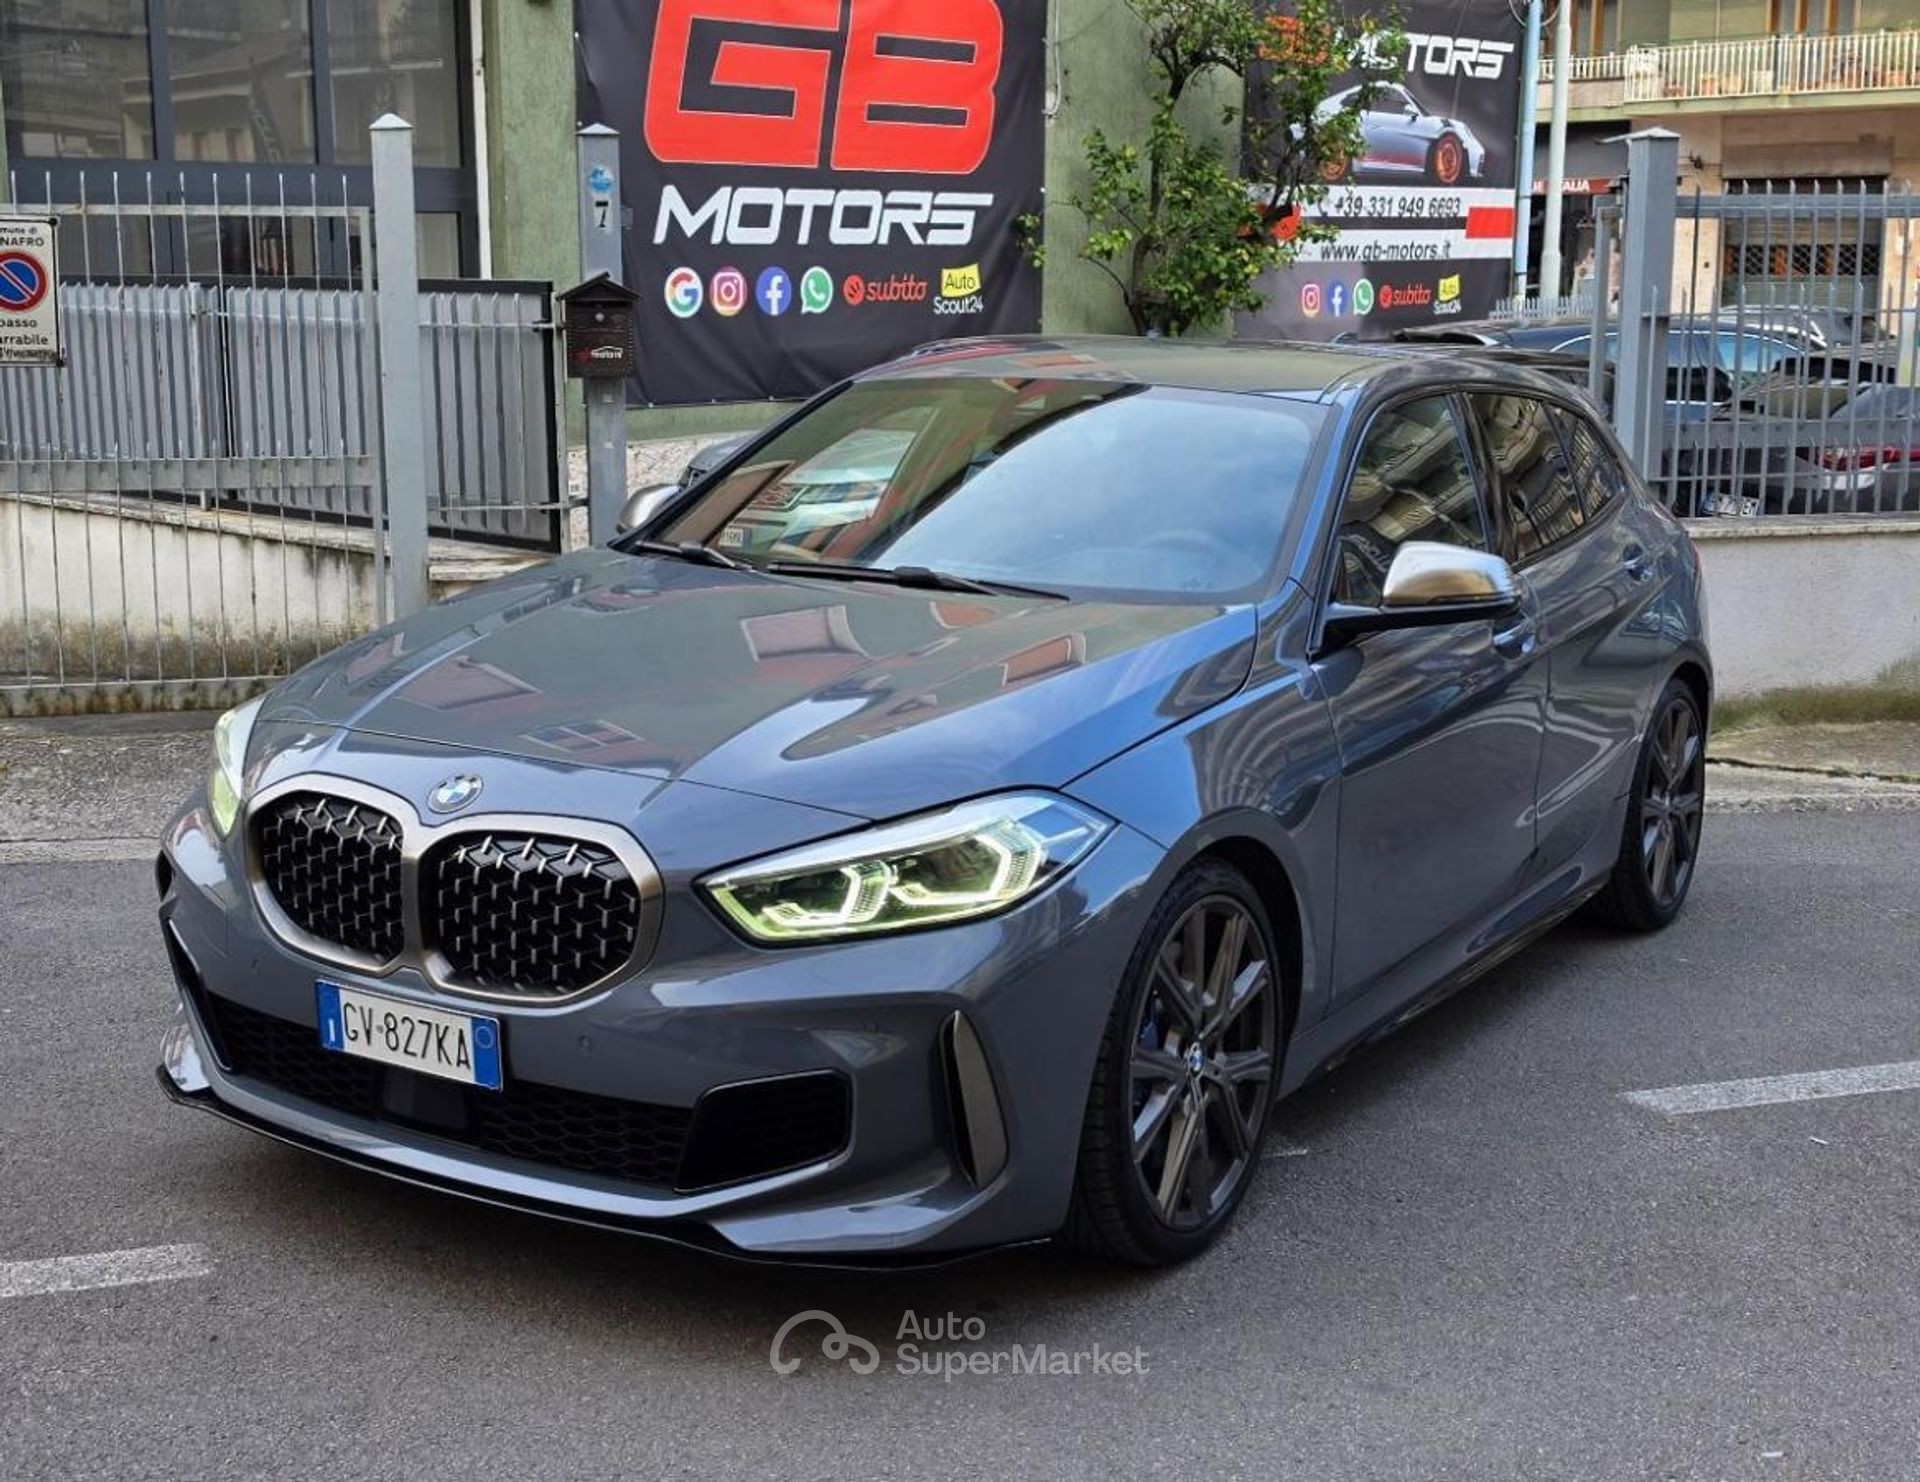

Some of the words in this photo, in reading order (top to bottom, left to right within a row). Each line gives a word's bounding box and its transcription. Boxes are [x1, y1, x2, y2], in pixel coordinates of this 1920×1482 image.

[644, 0, 1003, 174] GB
[595, 201, 608, 228] 7
[654, 184, 993, 245] MOTORS
[1335, 196, 1363, 217] +39
[1367, 196, 1393, 217] 331
[1398, 196, 1424, 217] 949
[1429, 196, 1460, 218] 6693
[1320, 239, 1451, 261] www.gb-motors.it
[866, 274, 928, 301] subito
[944, 272, 976, 290] Auto
[1393, 280, 1432, 306] subito
[933, 296, 985, 314] Scout24
